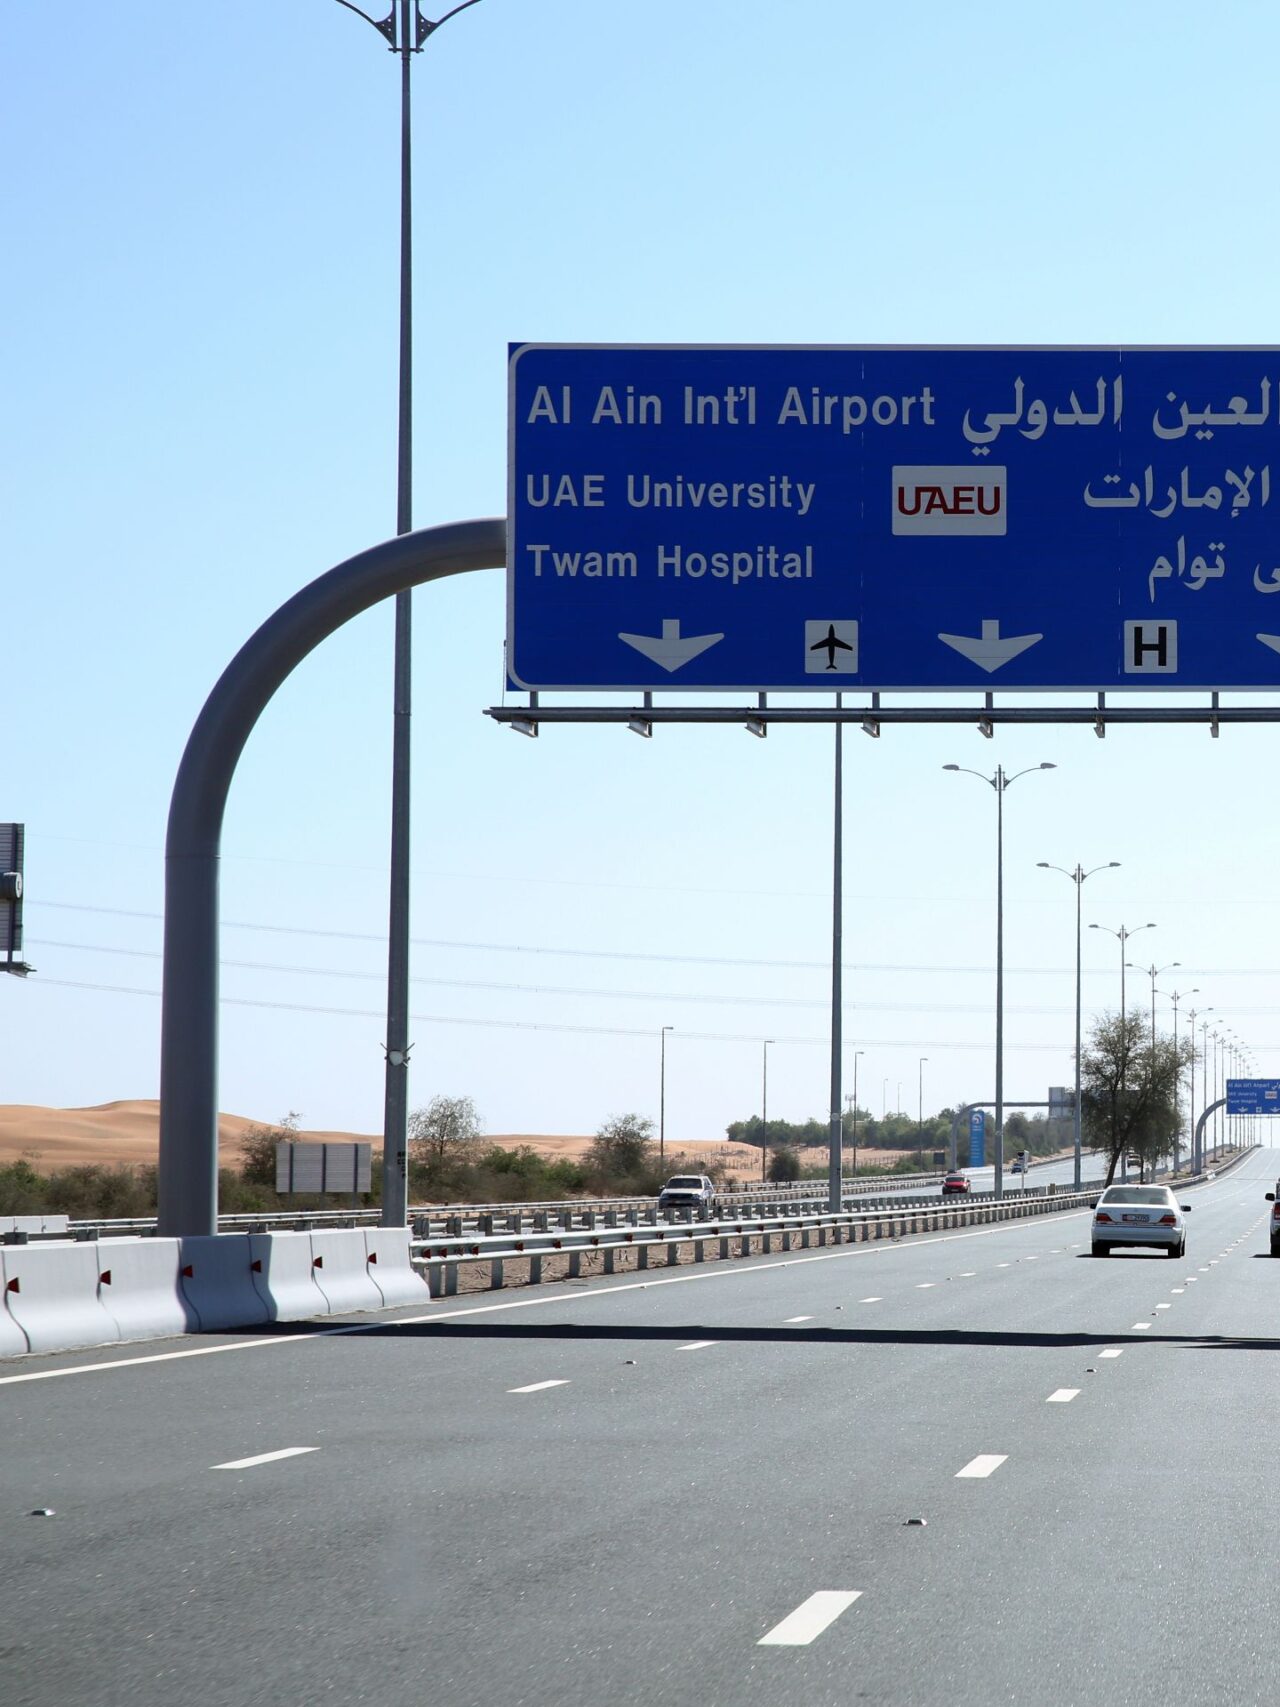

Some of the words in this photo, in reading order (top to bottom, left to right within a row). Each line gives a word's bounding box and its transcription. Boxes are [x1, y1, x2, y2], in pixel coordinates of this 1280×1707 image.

[527, 386, 571, 424] Al
[591, 386, 662, 425] Ain
[777, 387, 935, 435] Airport
[962, 374, 1123, 457] الدولي
[527, 475, 605, 507] UAE
[627, 475, 816, 515] University
[898, 486, 1001, 516] UAEU
[1083, 464, 1270, 518] الإمارات
[526, 544, 637, 577] Twam
[657, 545, 813, 585] Hospital
[1148, 535, 1226, 603] توام
[1133, 626, 1167, 667] H
